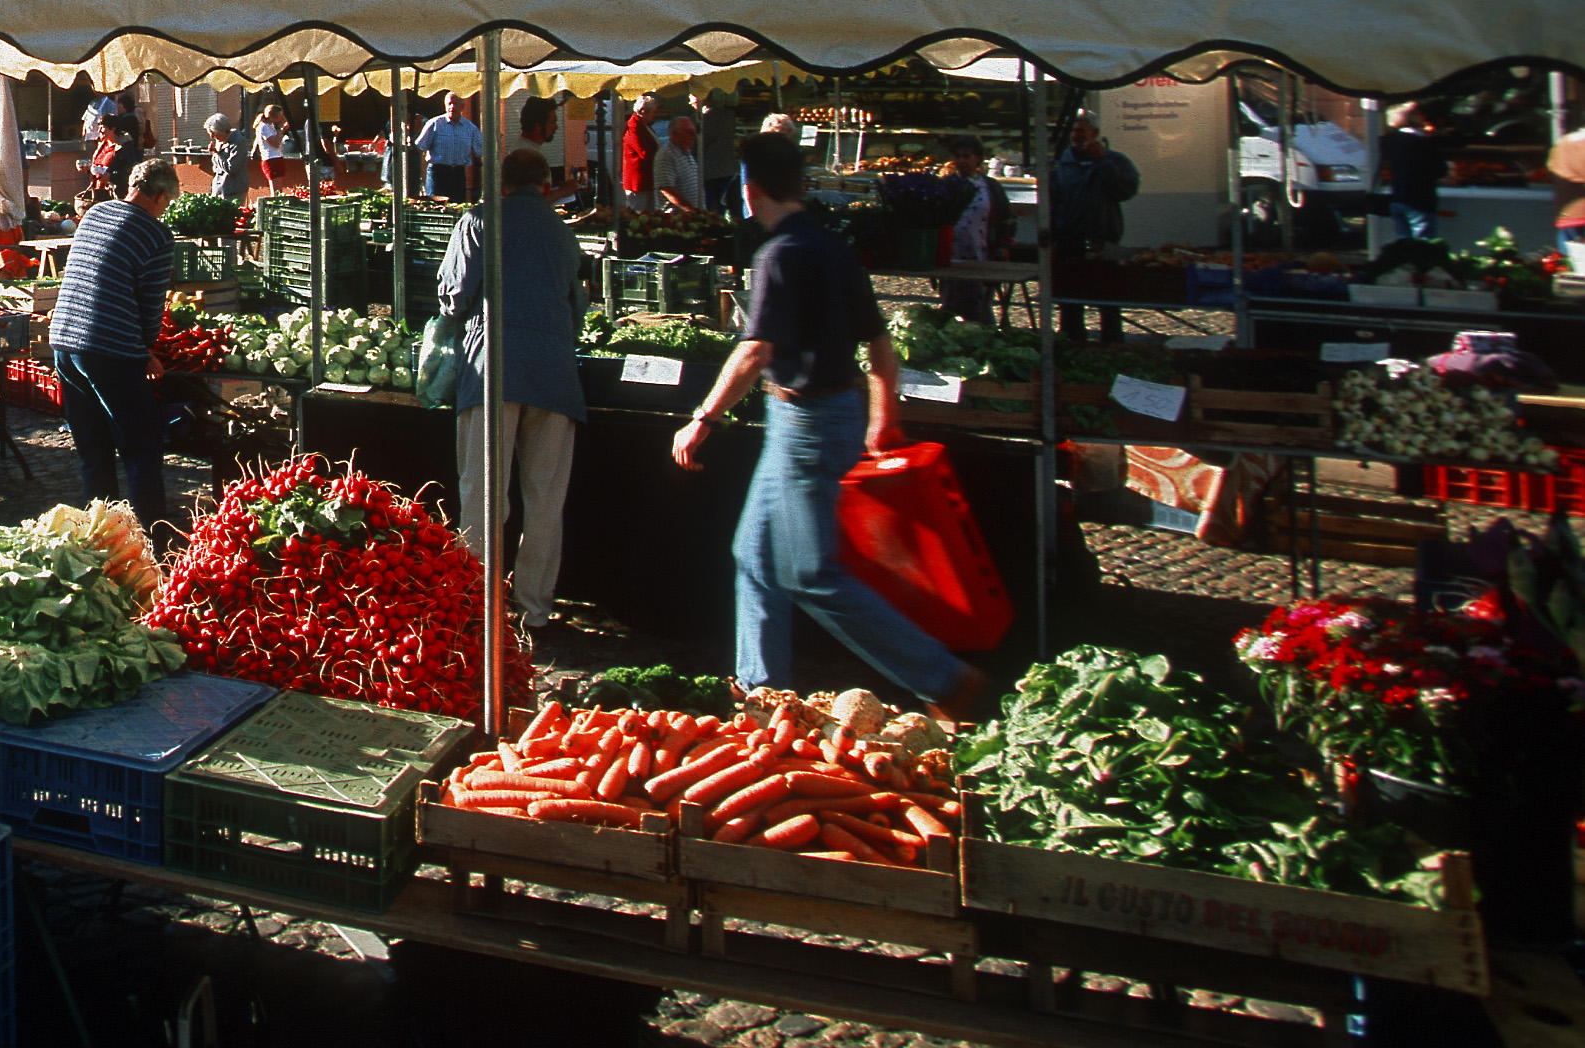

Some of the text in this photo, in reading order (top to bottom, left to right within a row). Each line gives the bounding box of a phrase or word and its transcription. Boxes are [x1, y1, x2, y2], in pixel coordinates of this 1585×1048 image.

[1061, 876, 1089, 906] IL
[1098, 882, 1194, 923] GUSTO
[1203, 899, 1263, 937] DEL
